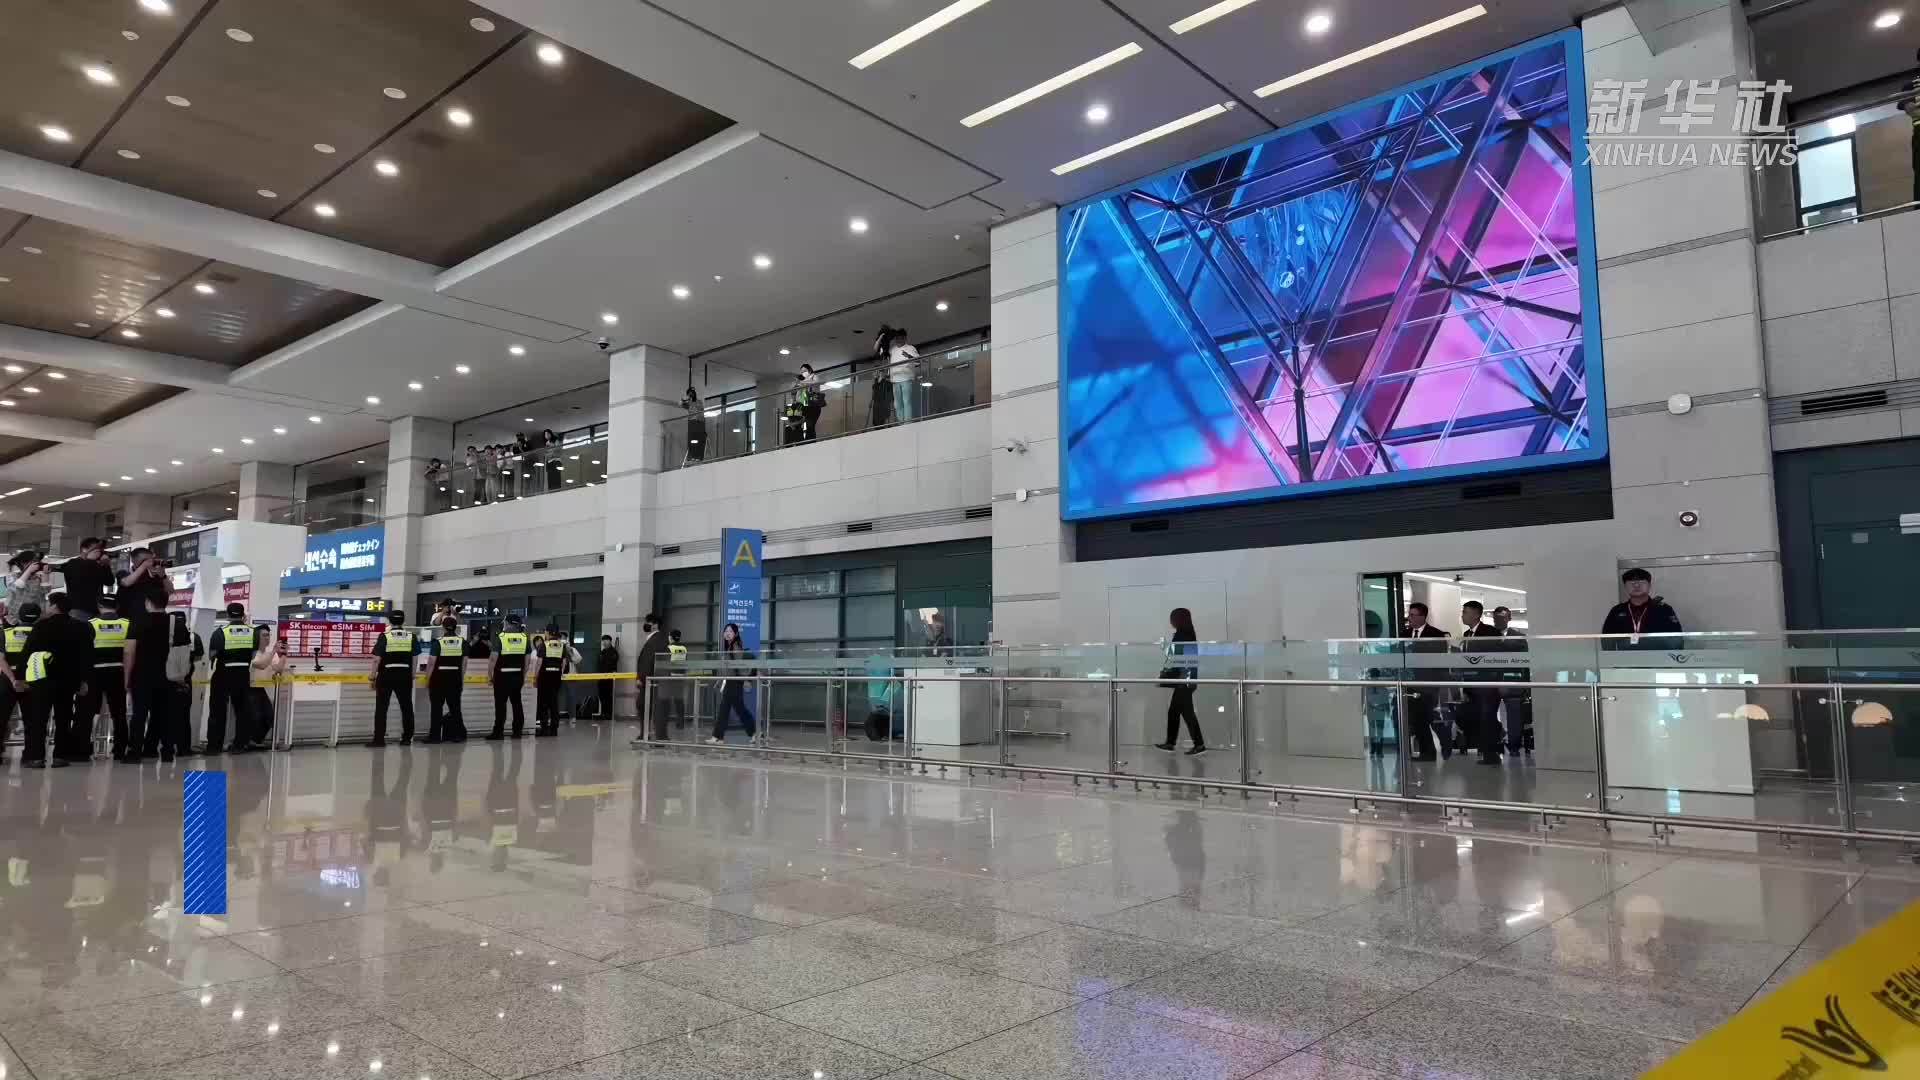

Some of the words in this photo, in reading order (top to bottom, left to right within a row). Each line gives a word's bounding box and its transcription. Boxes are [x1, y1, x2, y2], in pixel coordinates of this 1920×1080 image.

[300, 547, 337, 573] 내선수속
[733, 539, 757, 568] A
[366, 600, 385, 611] B-F
[289, 621, 301, 630] SK
[301, 622, 328, 630] telecom
[332, 623, 353, 631] eSIM
[359, 623, 375, 631] SIM
